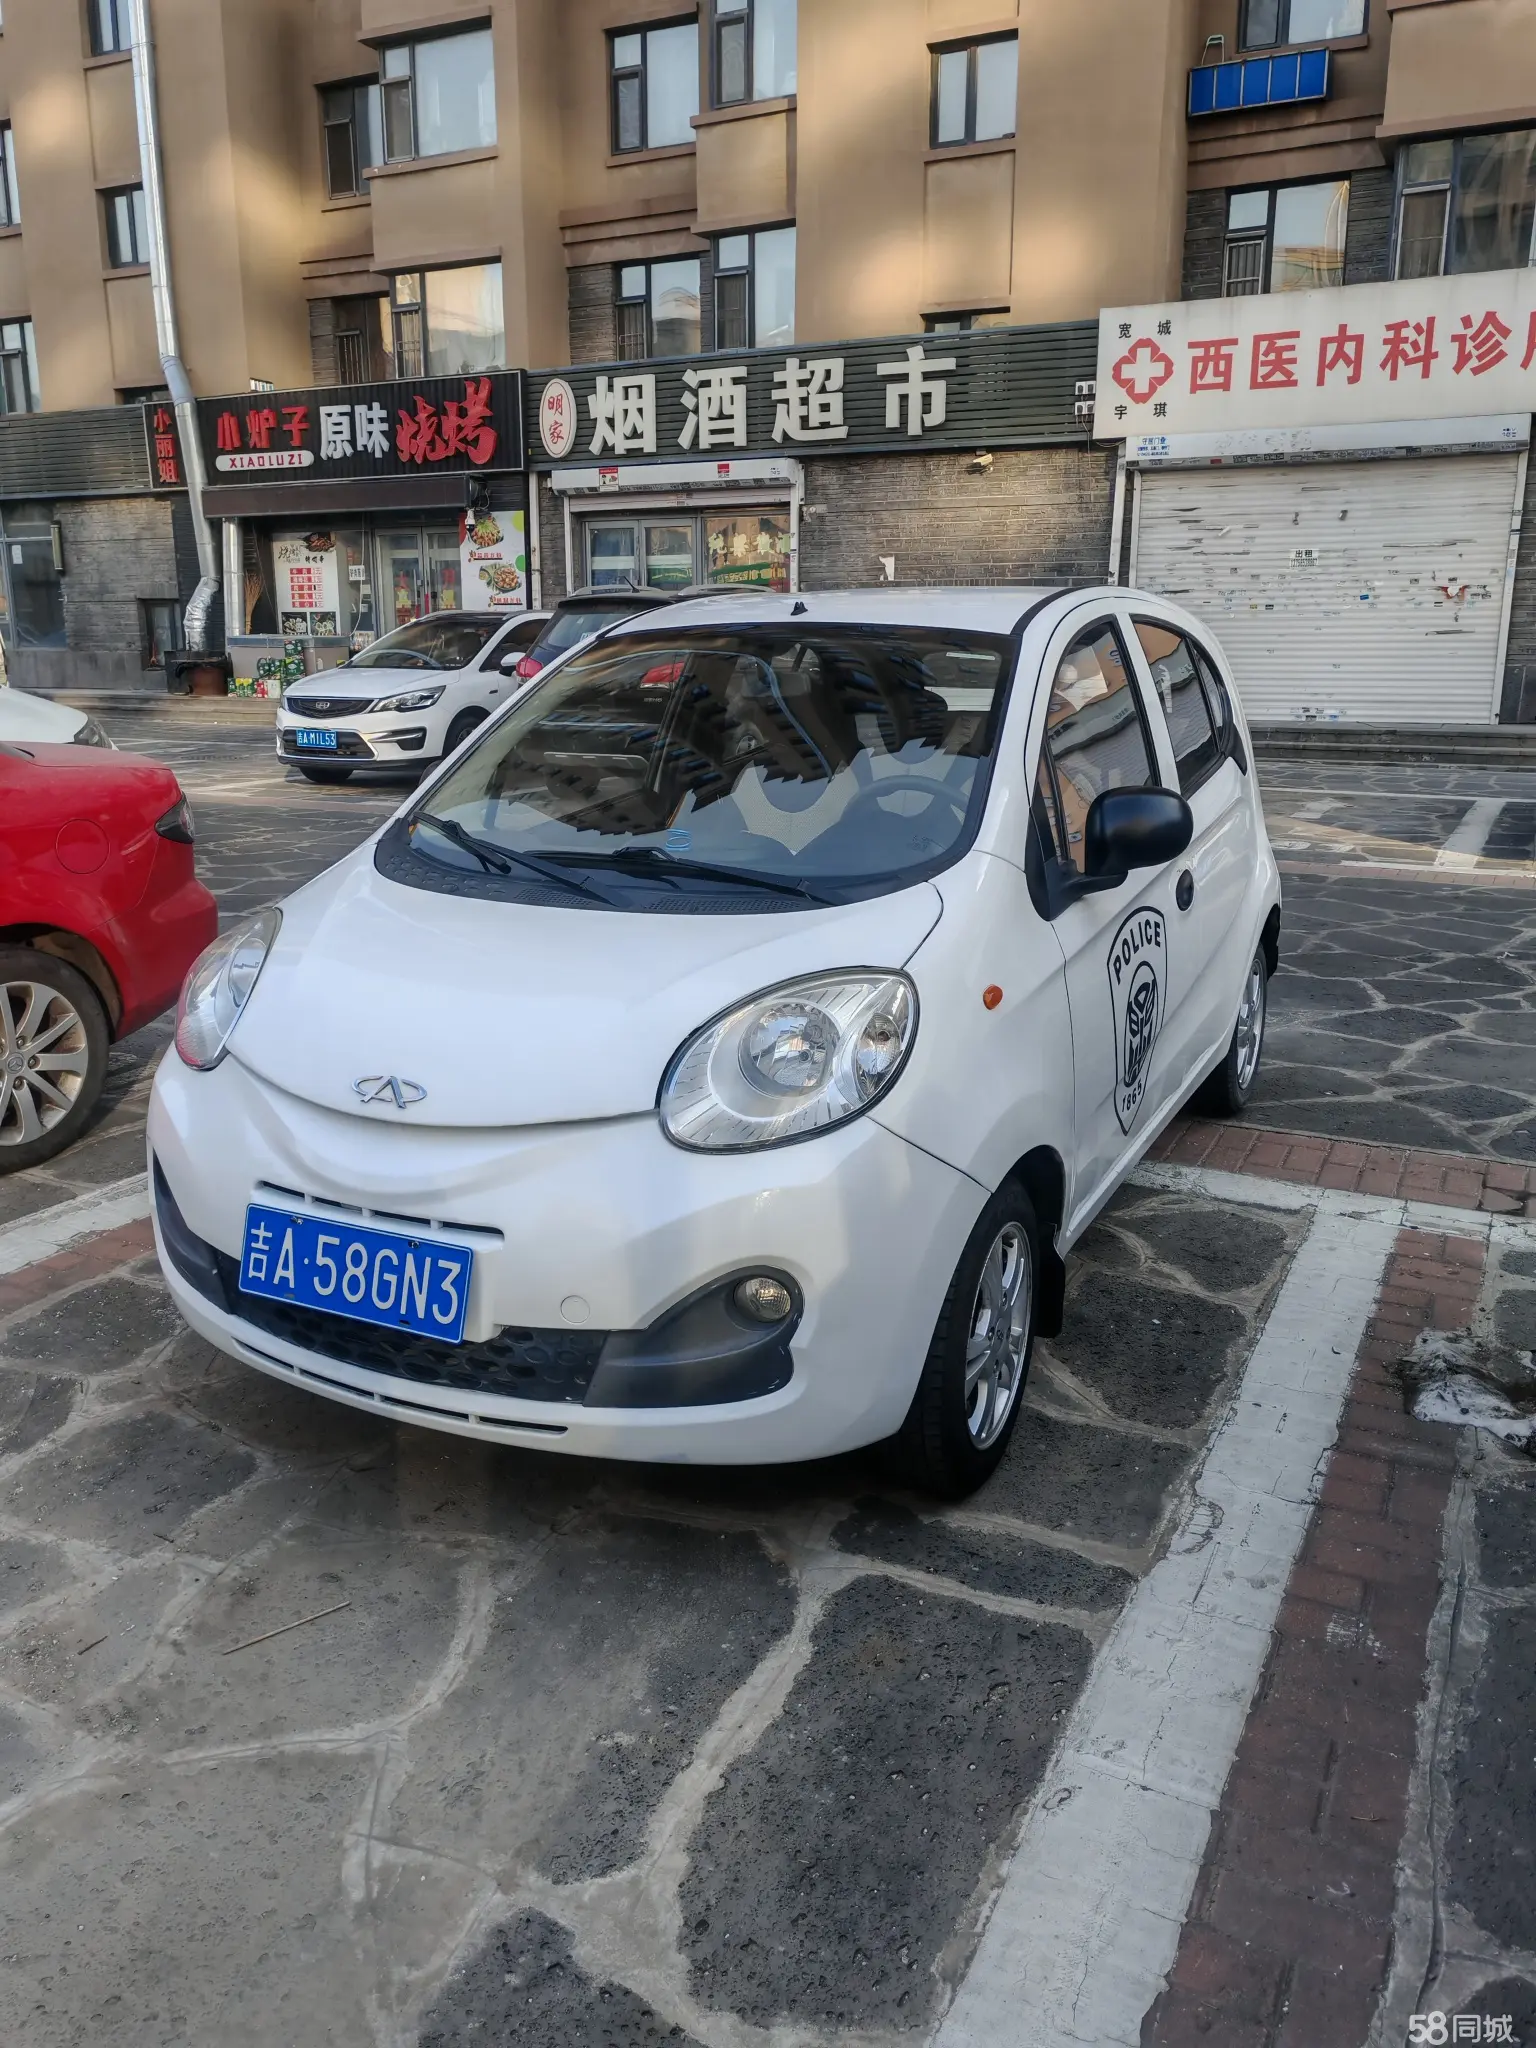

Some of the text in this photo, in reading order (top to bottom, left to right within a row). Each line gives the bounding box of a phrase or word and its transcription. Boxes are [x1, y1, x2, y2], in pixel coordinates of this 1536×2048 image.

[1187, 311, 1536, 394] 西医内科诊
[548, 393, 565, 445] 明家
[588, 345, 957, 455] 烟酒超市
[154, 407, 180, 484] 小丽姐
[229, 452, 304, 468] XIAOLUZI
[1113, 918, 1161, 985] POLICE
